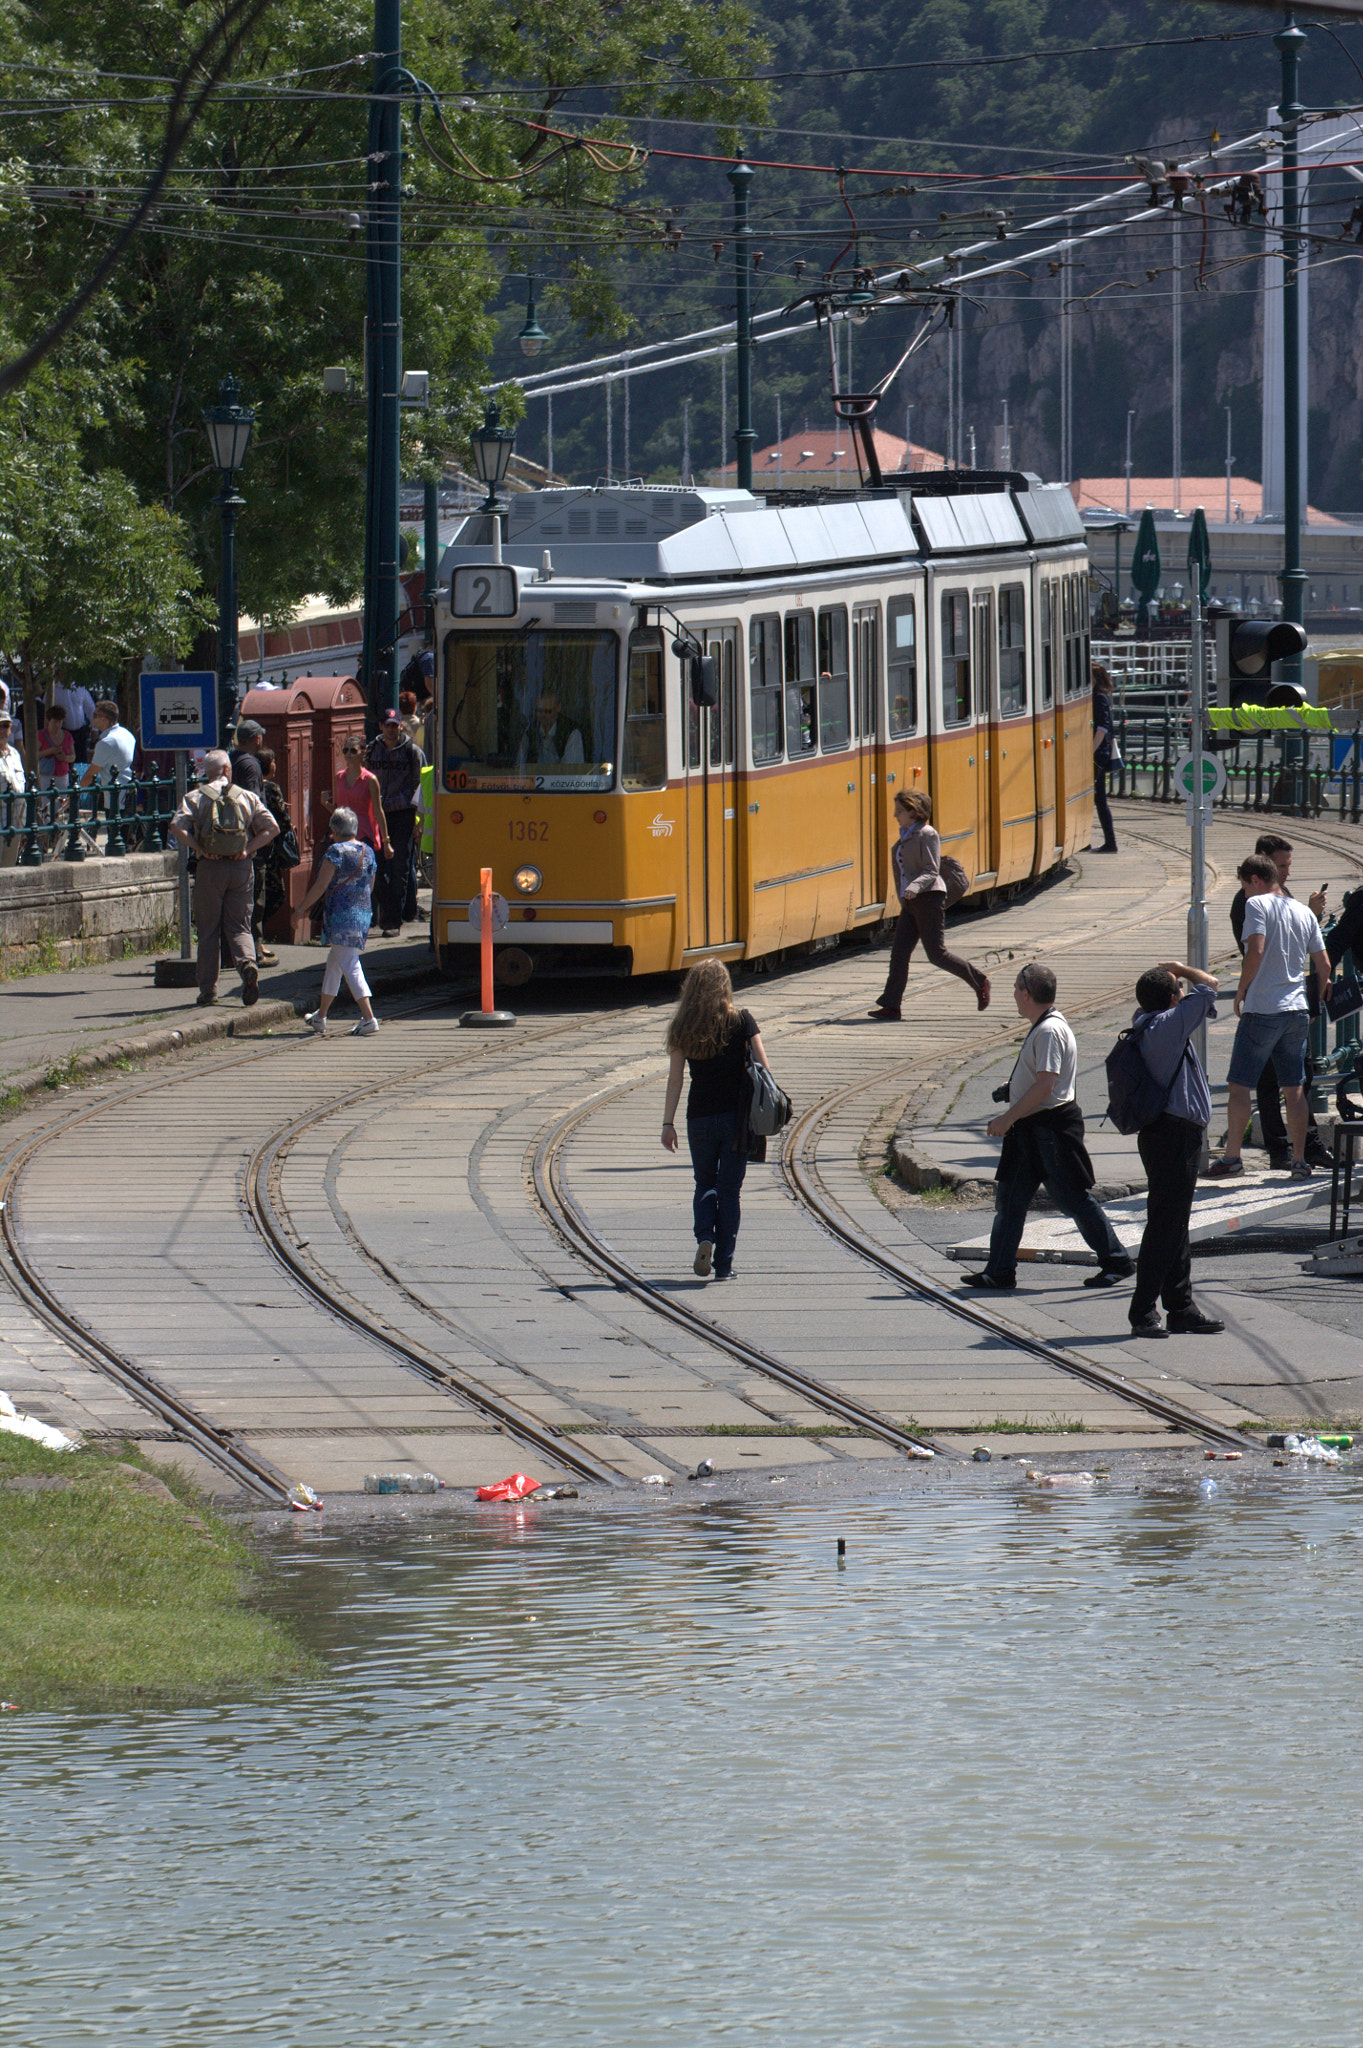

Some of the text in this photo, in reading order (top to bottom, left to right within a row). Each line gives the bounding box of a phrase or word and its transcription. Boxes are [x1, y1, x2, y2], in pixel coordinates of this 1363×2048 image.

[472, 576, 492, 613] 2
[535, 776, 545, 790] 2
[508, 820, 549, 842] 1362
